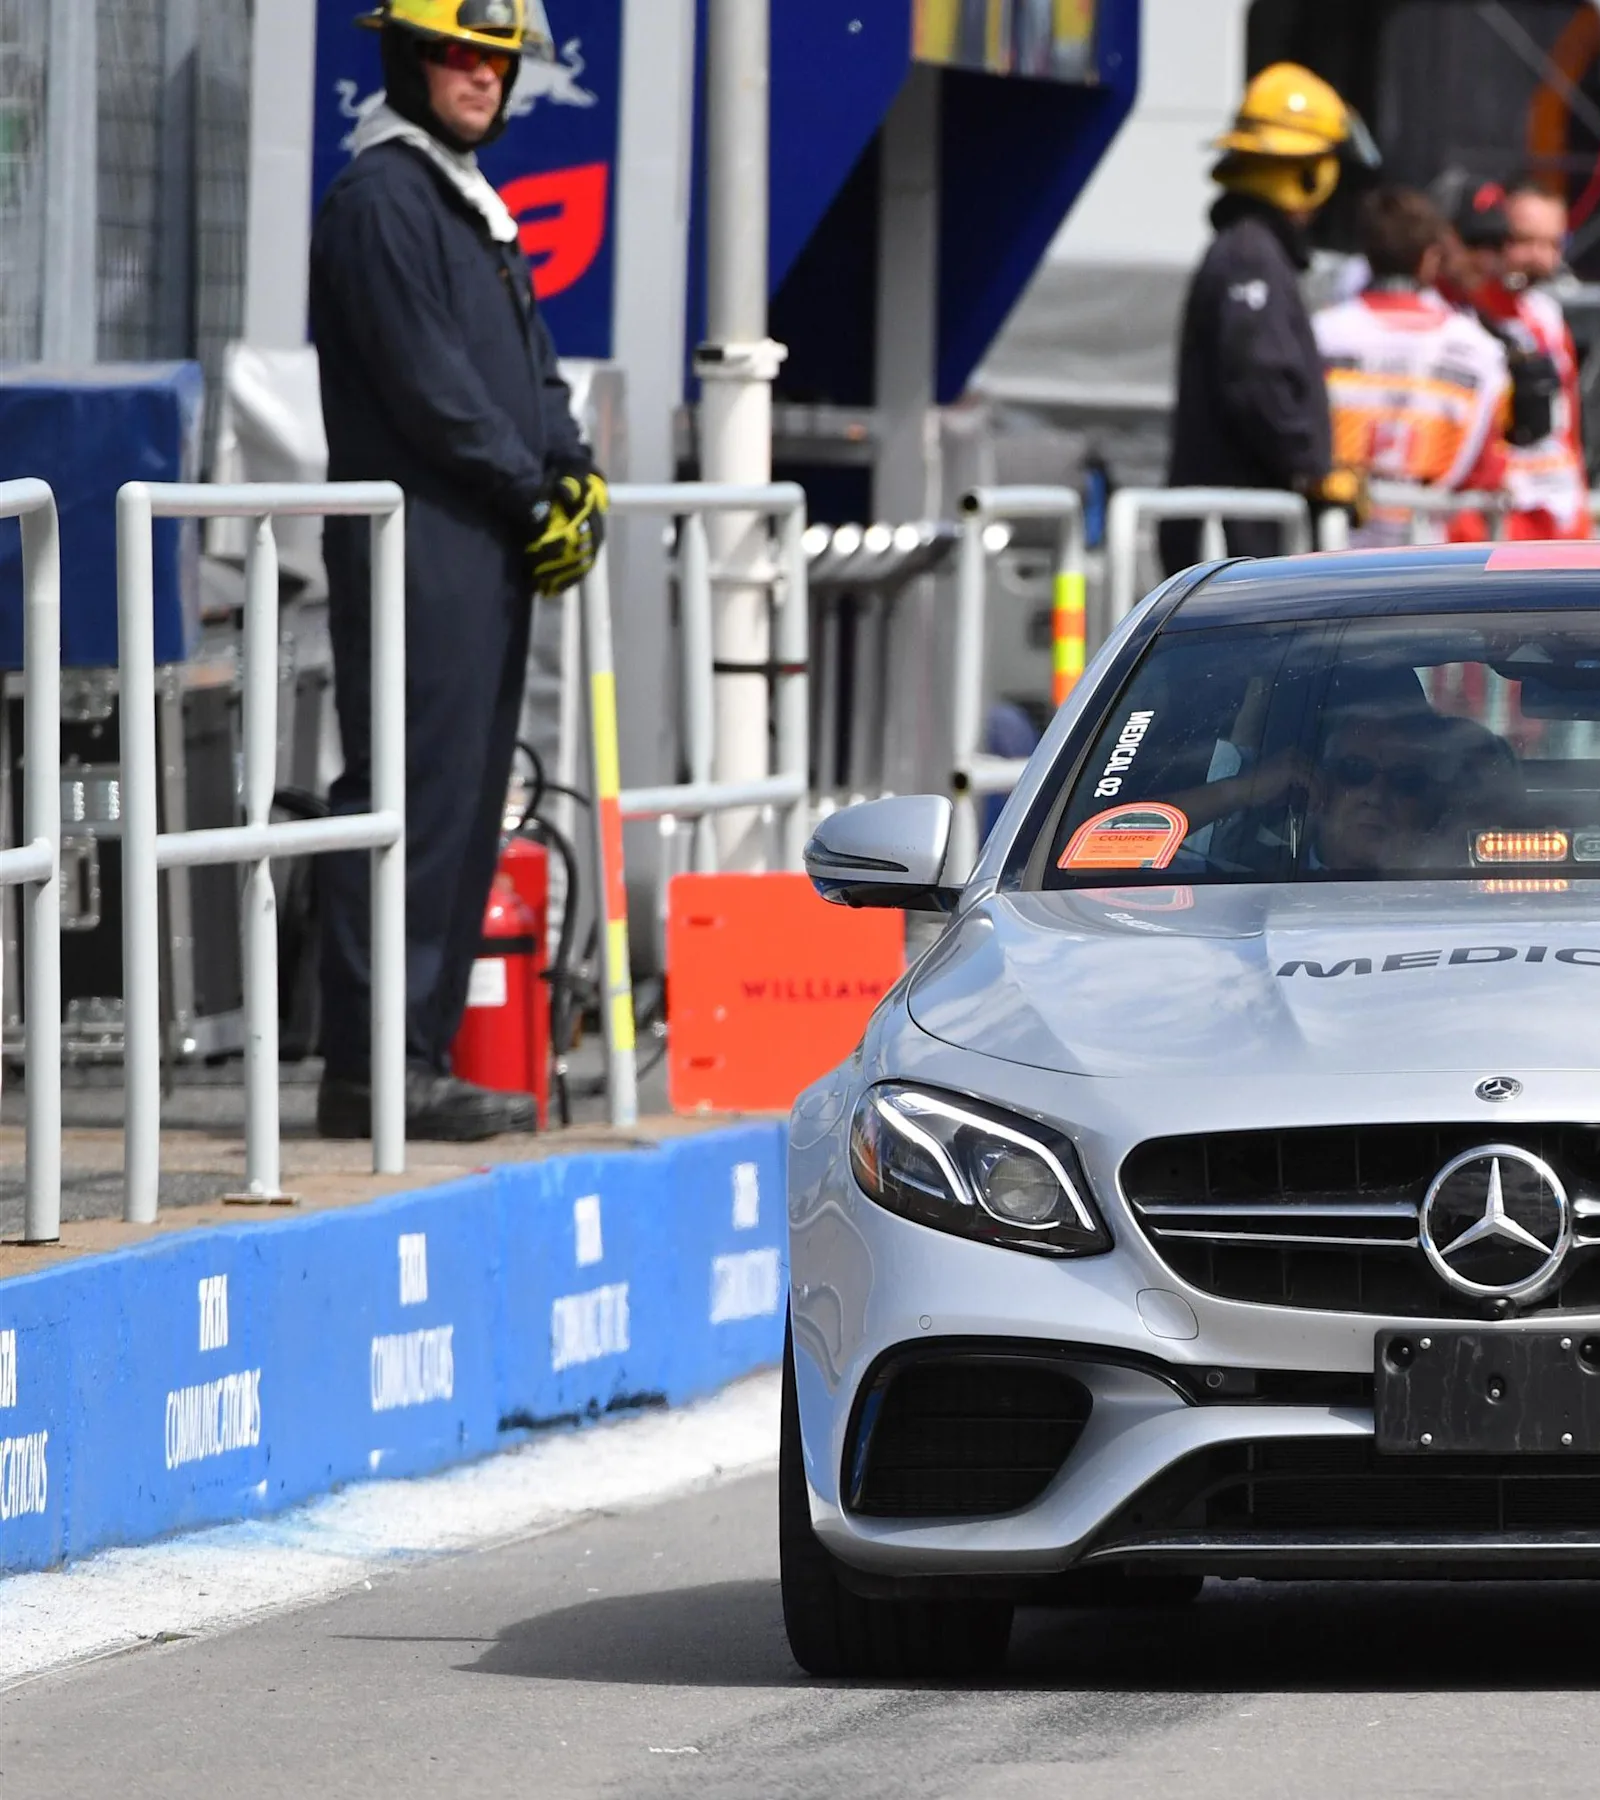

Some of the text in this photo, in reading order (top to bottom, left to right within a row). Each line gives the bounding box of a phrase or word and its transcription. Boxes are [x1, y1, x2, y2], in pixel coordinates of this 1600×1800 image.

[1103, 710, 1155, 776] MEDICAL
[1093, 776, 1123, 798] 02
[198, 1273, 229, 1352] TATA
[0, 1328, 17, 1408] TA
[0, 1429, 48, 1520] CATIONS
